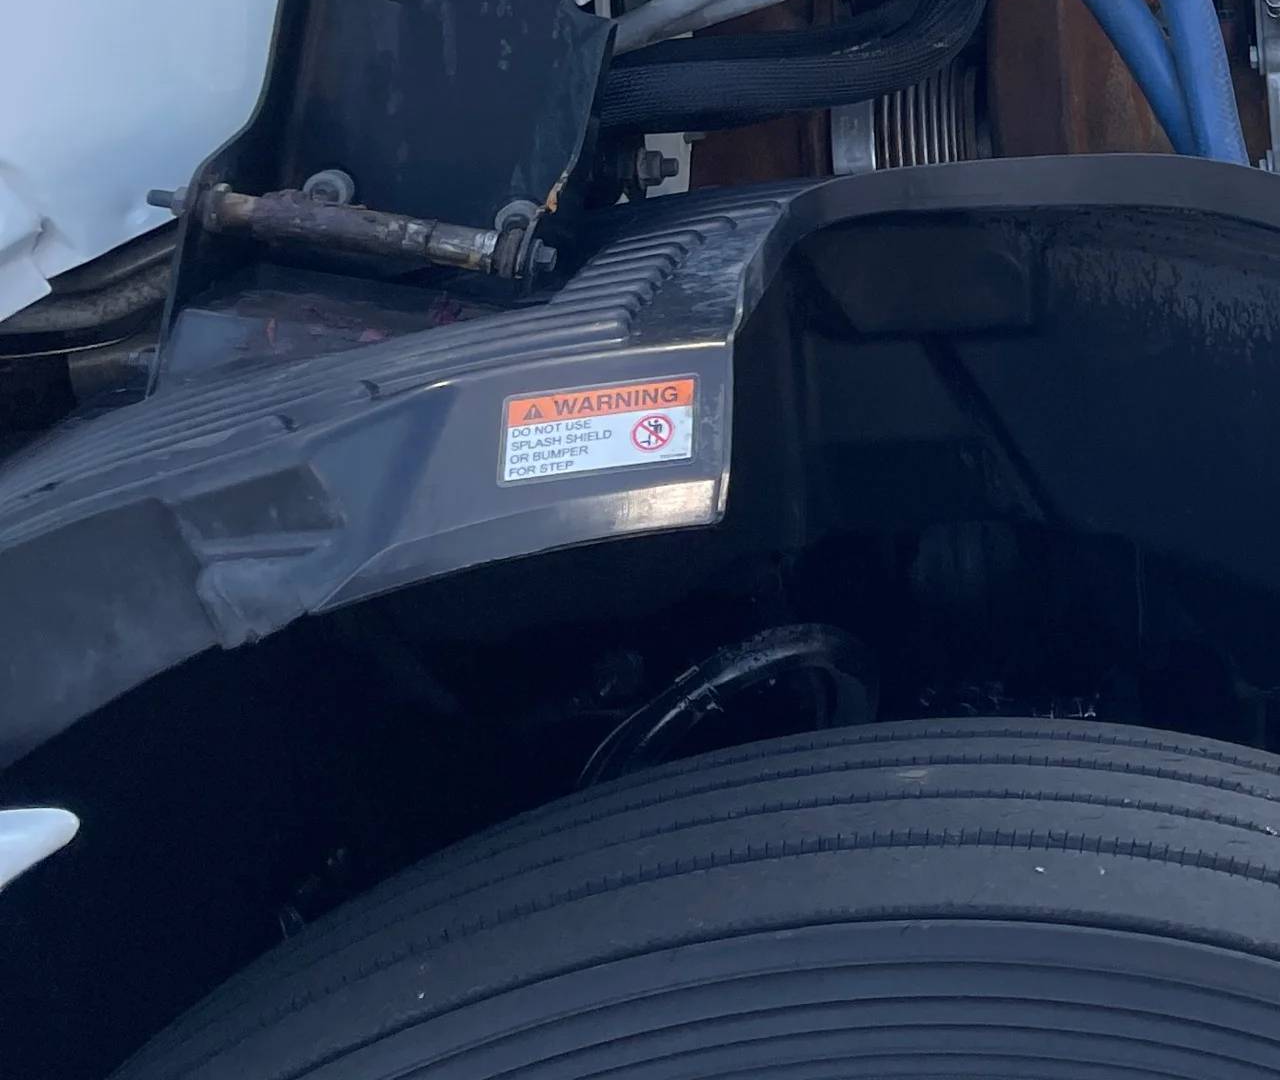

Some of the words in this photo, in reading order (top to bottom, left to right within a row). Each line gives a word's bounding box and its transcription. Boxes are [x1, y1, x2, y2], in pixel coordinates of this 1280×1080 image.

[553, 386, 679, 416] WARNING
[512, 427, 531, 438] DO
[534, 422, 562, 435] NOT
[565, 419, 592, 431] USE
[511, 435, 562, 452] SPLASH
[566, 429, 613, 445] SHIELD
[510, 453, 530, 465] OR
[532, 445, 589, 462] BUMPER
[509, 465, 537, 477] FOR
[539, 460, 574, 474] STEP
